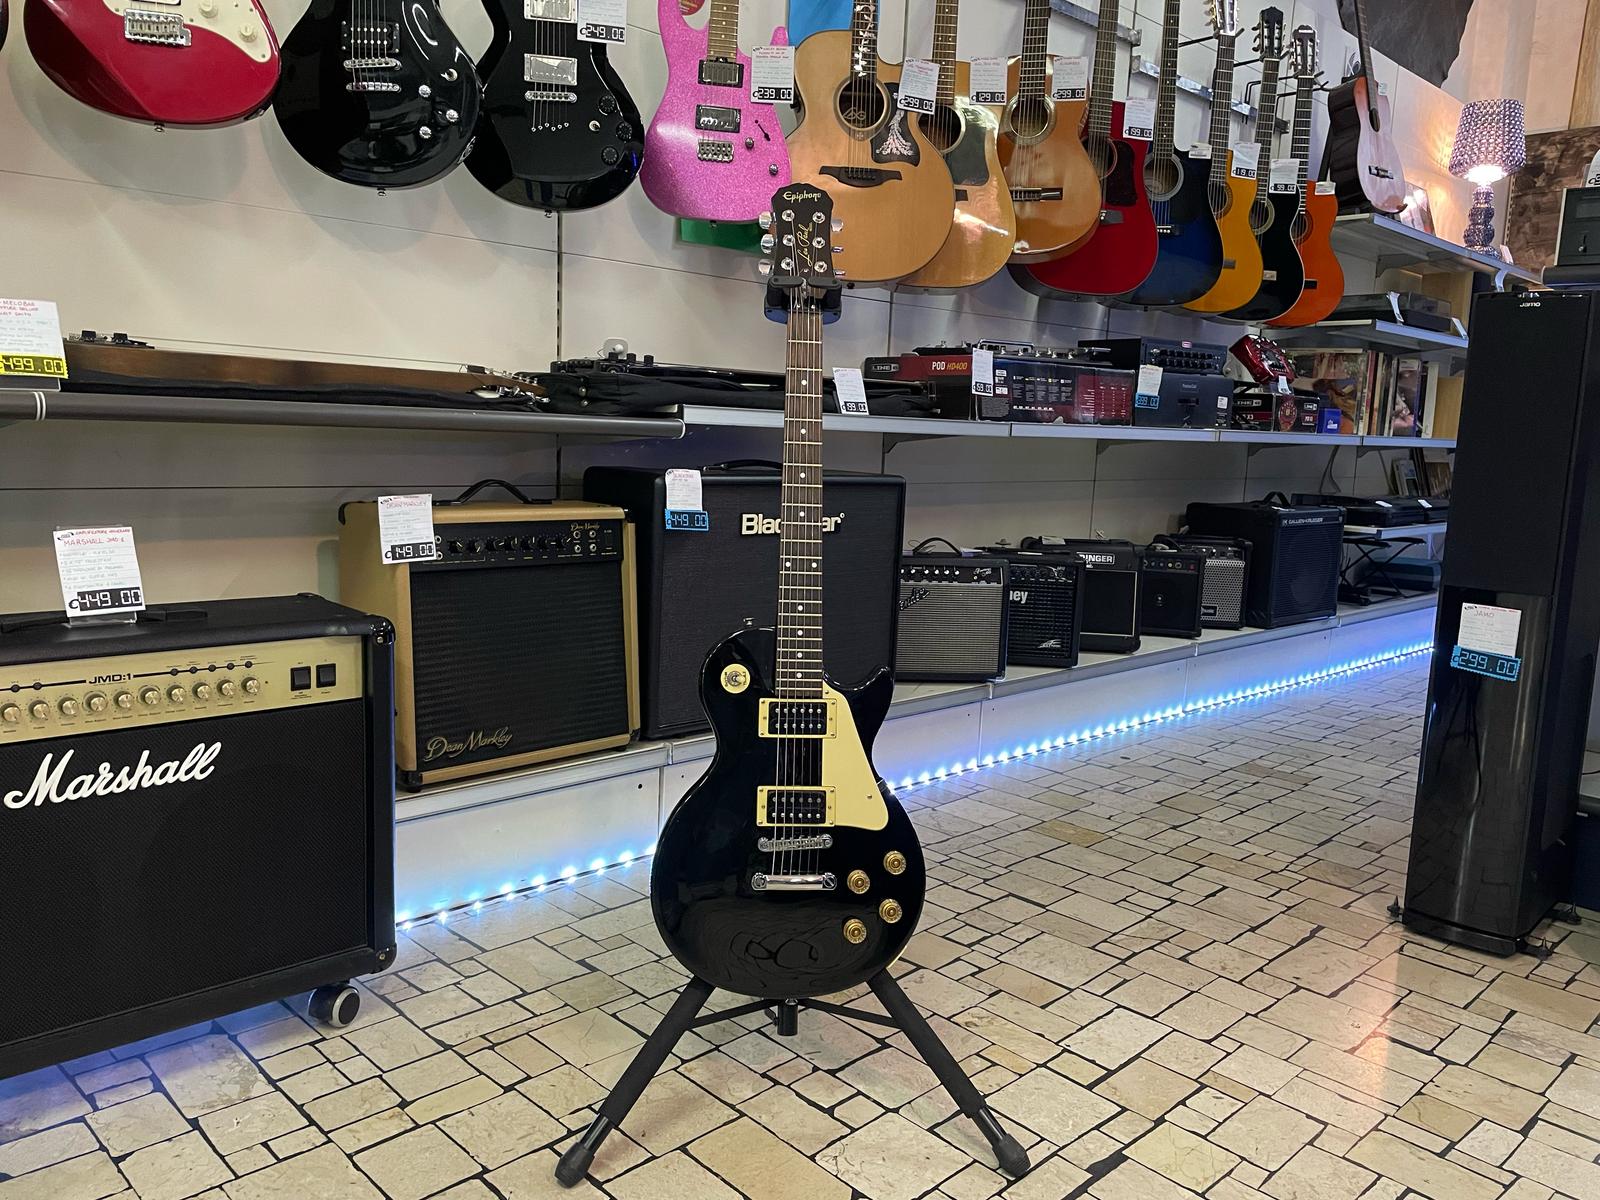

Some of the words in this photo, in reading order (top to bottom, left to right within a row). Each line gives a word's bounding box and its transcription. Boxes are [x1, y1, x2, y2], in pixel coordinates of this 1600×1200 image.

[783, 190, 821, 203] Epiphone
[932, 361, 946, 371] POD
[88, 672, 131, 684] JMD:1
[3, 741, 222, 810] Marshall
